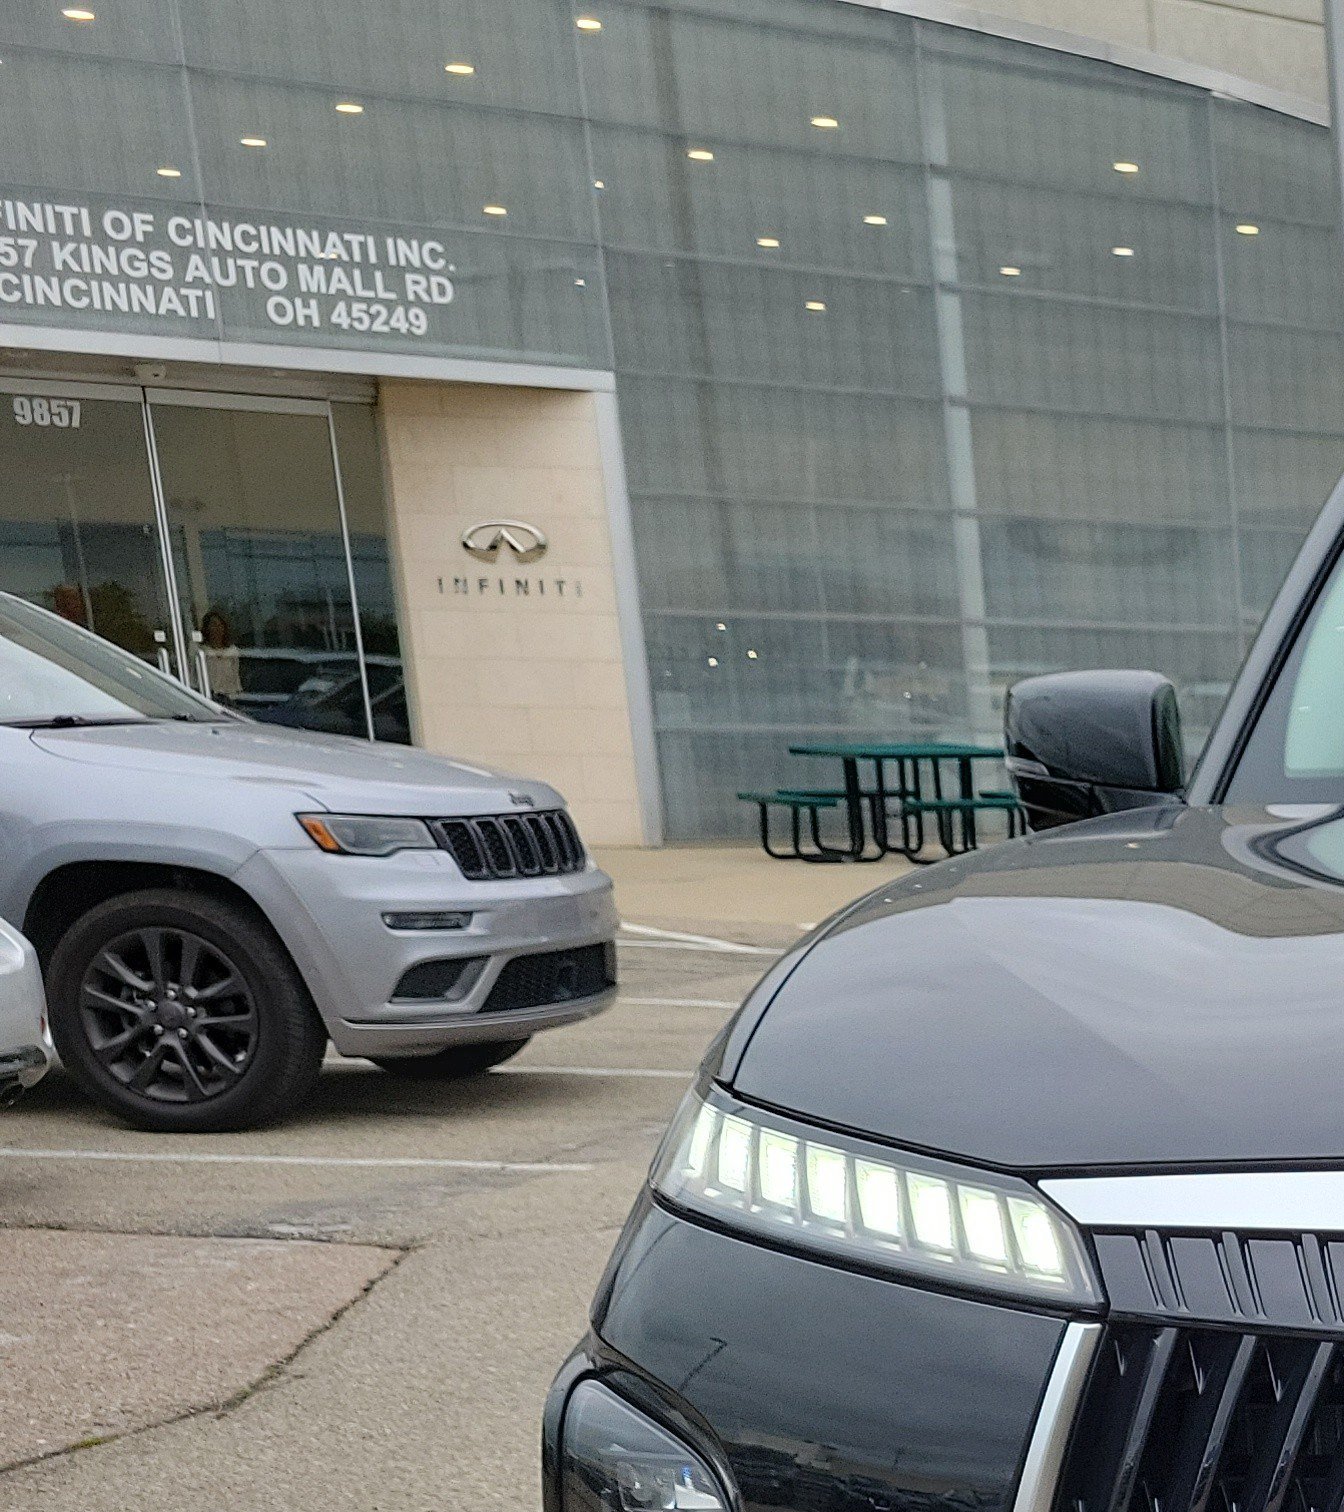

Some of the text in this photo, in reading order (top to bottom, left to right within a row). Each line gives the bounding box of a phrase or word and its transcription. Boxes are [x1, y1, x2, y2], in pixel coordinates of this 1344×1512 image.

[0, 200, 456, 272] INITI OF CINCINNATI INC.
[0, 271, 428, 336] CINCINNATI OH 45249
[51, 240, 174, 281] KINGS
[184, 254, 289, 292] AUTO
[296, 262, 398, 300] MALL
[404, 272, 454, 305] RD
[13, 396, 81, 429] 9857
[437, 576, 583, 599] INFINITI
